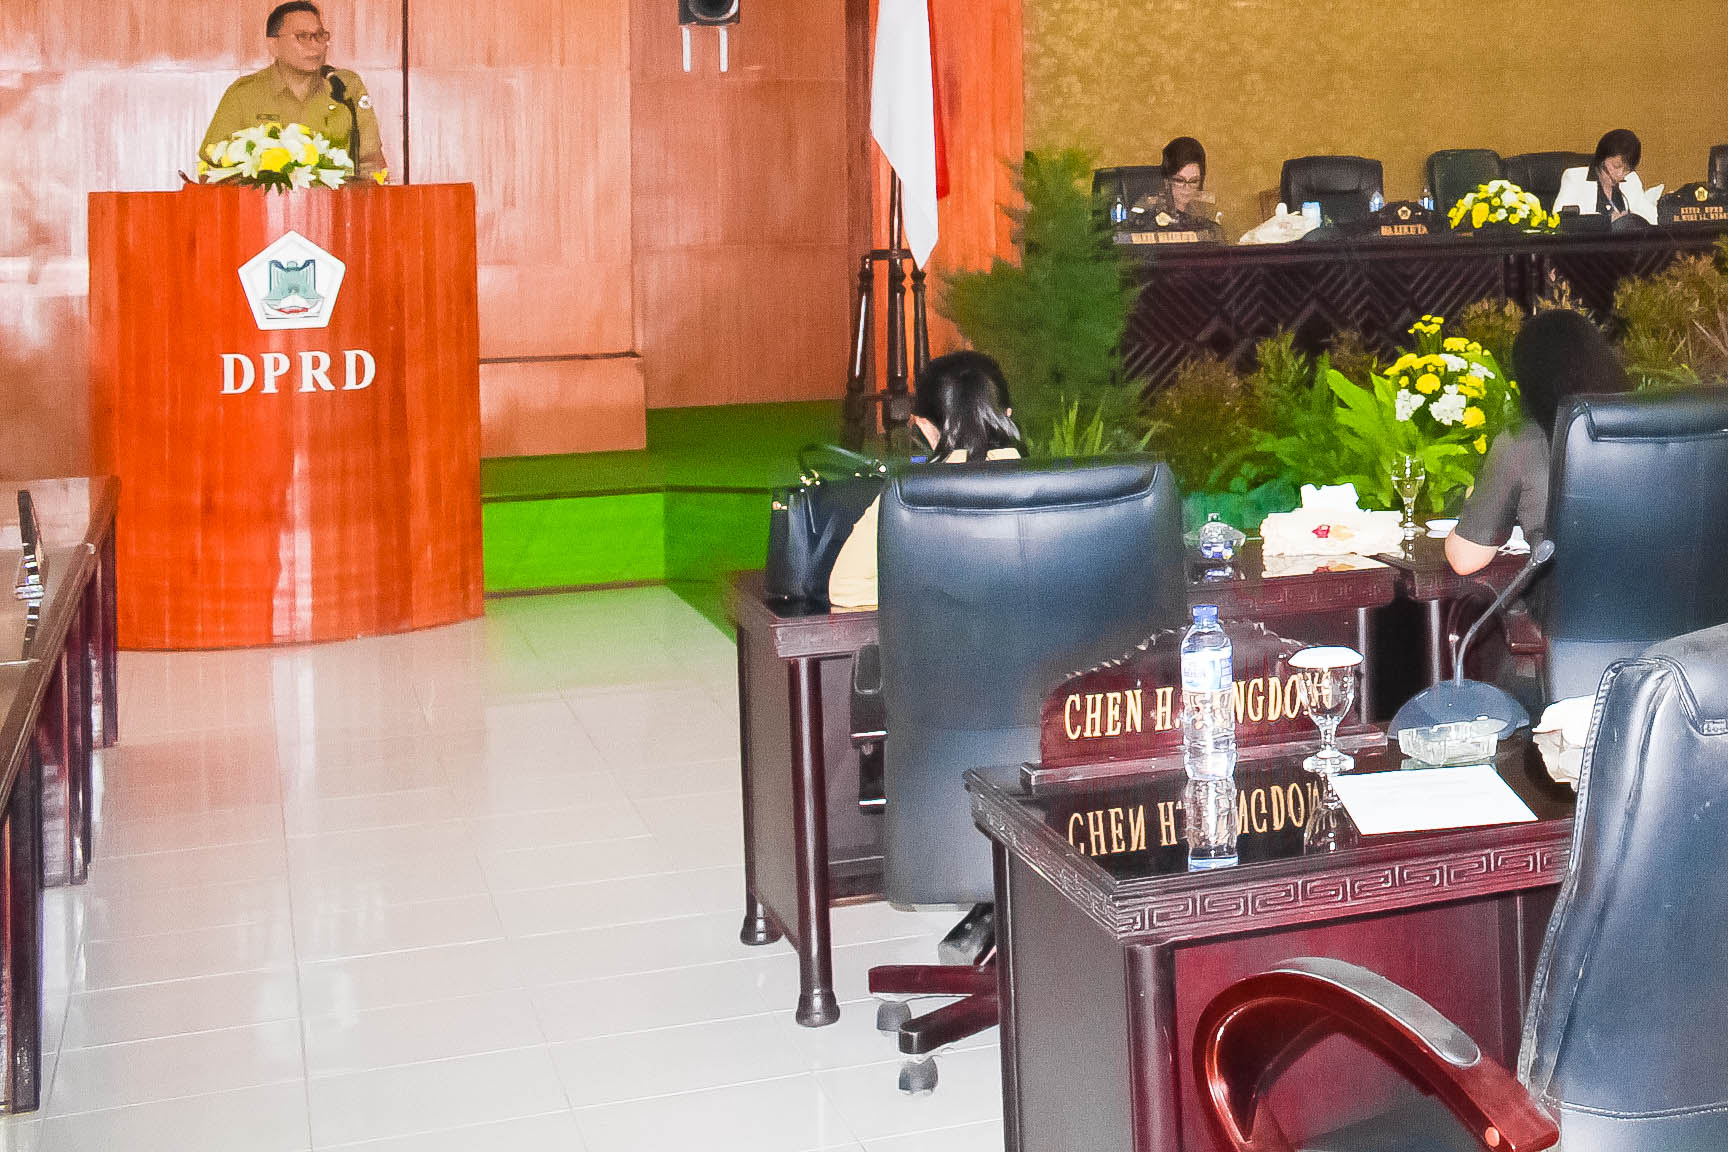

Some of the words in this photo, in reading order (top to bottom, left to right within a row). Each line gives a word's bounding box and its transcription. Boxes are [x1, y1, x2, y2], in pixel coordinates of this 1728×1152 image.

[220, 349, 377, 394] DPRD
[1063, 689, 1143, 740] CHEN
[1154, 686, 1182, 731] H.
